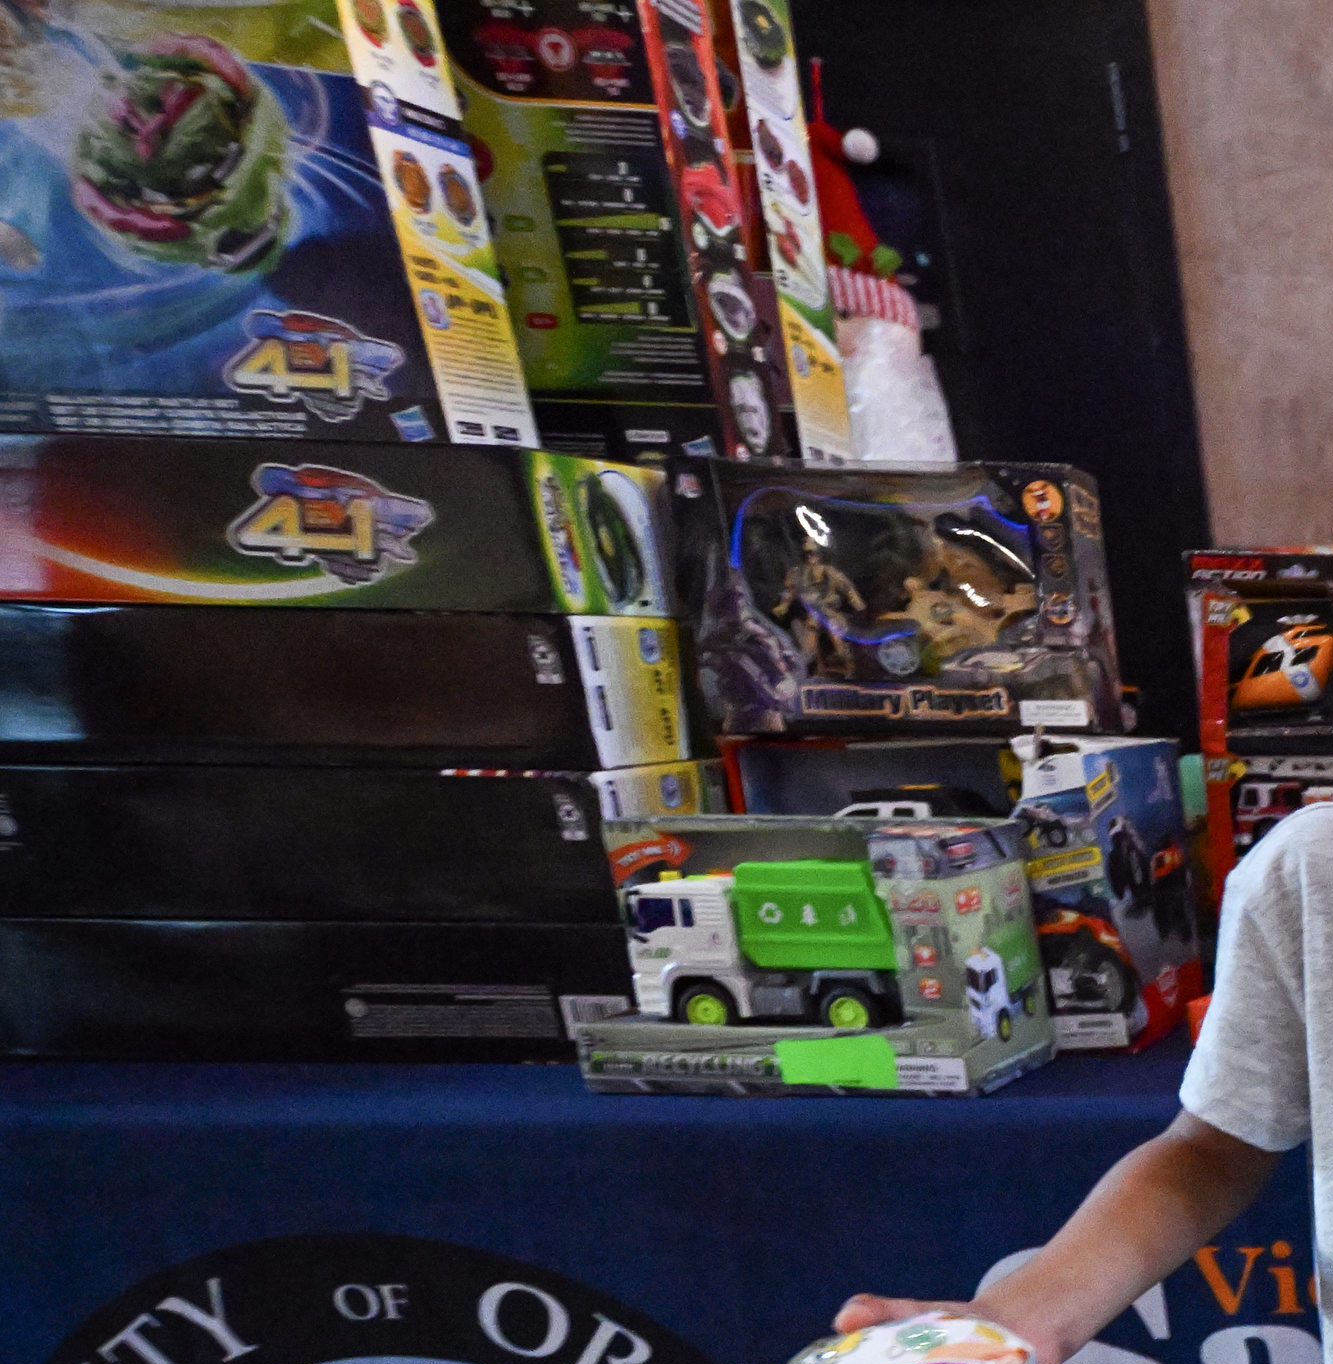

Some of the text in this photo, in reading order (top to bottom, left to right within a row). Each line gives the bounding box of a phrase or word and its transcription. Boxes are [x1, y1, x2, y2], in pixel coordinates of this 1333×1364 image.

[910, 686, 1008, 718] Playset
[1194, 1239, 1318, 1316] Vi
[333, 1284, 410, 1321] OF
